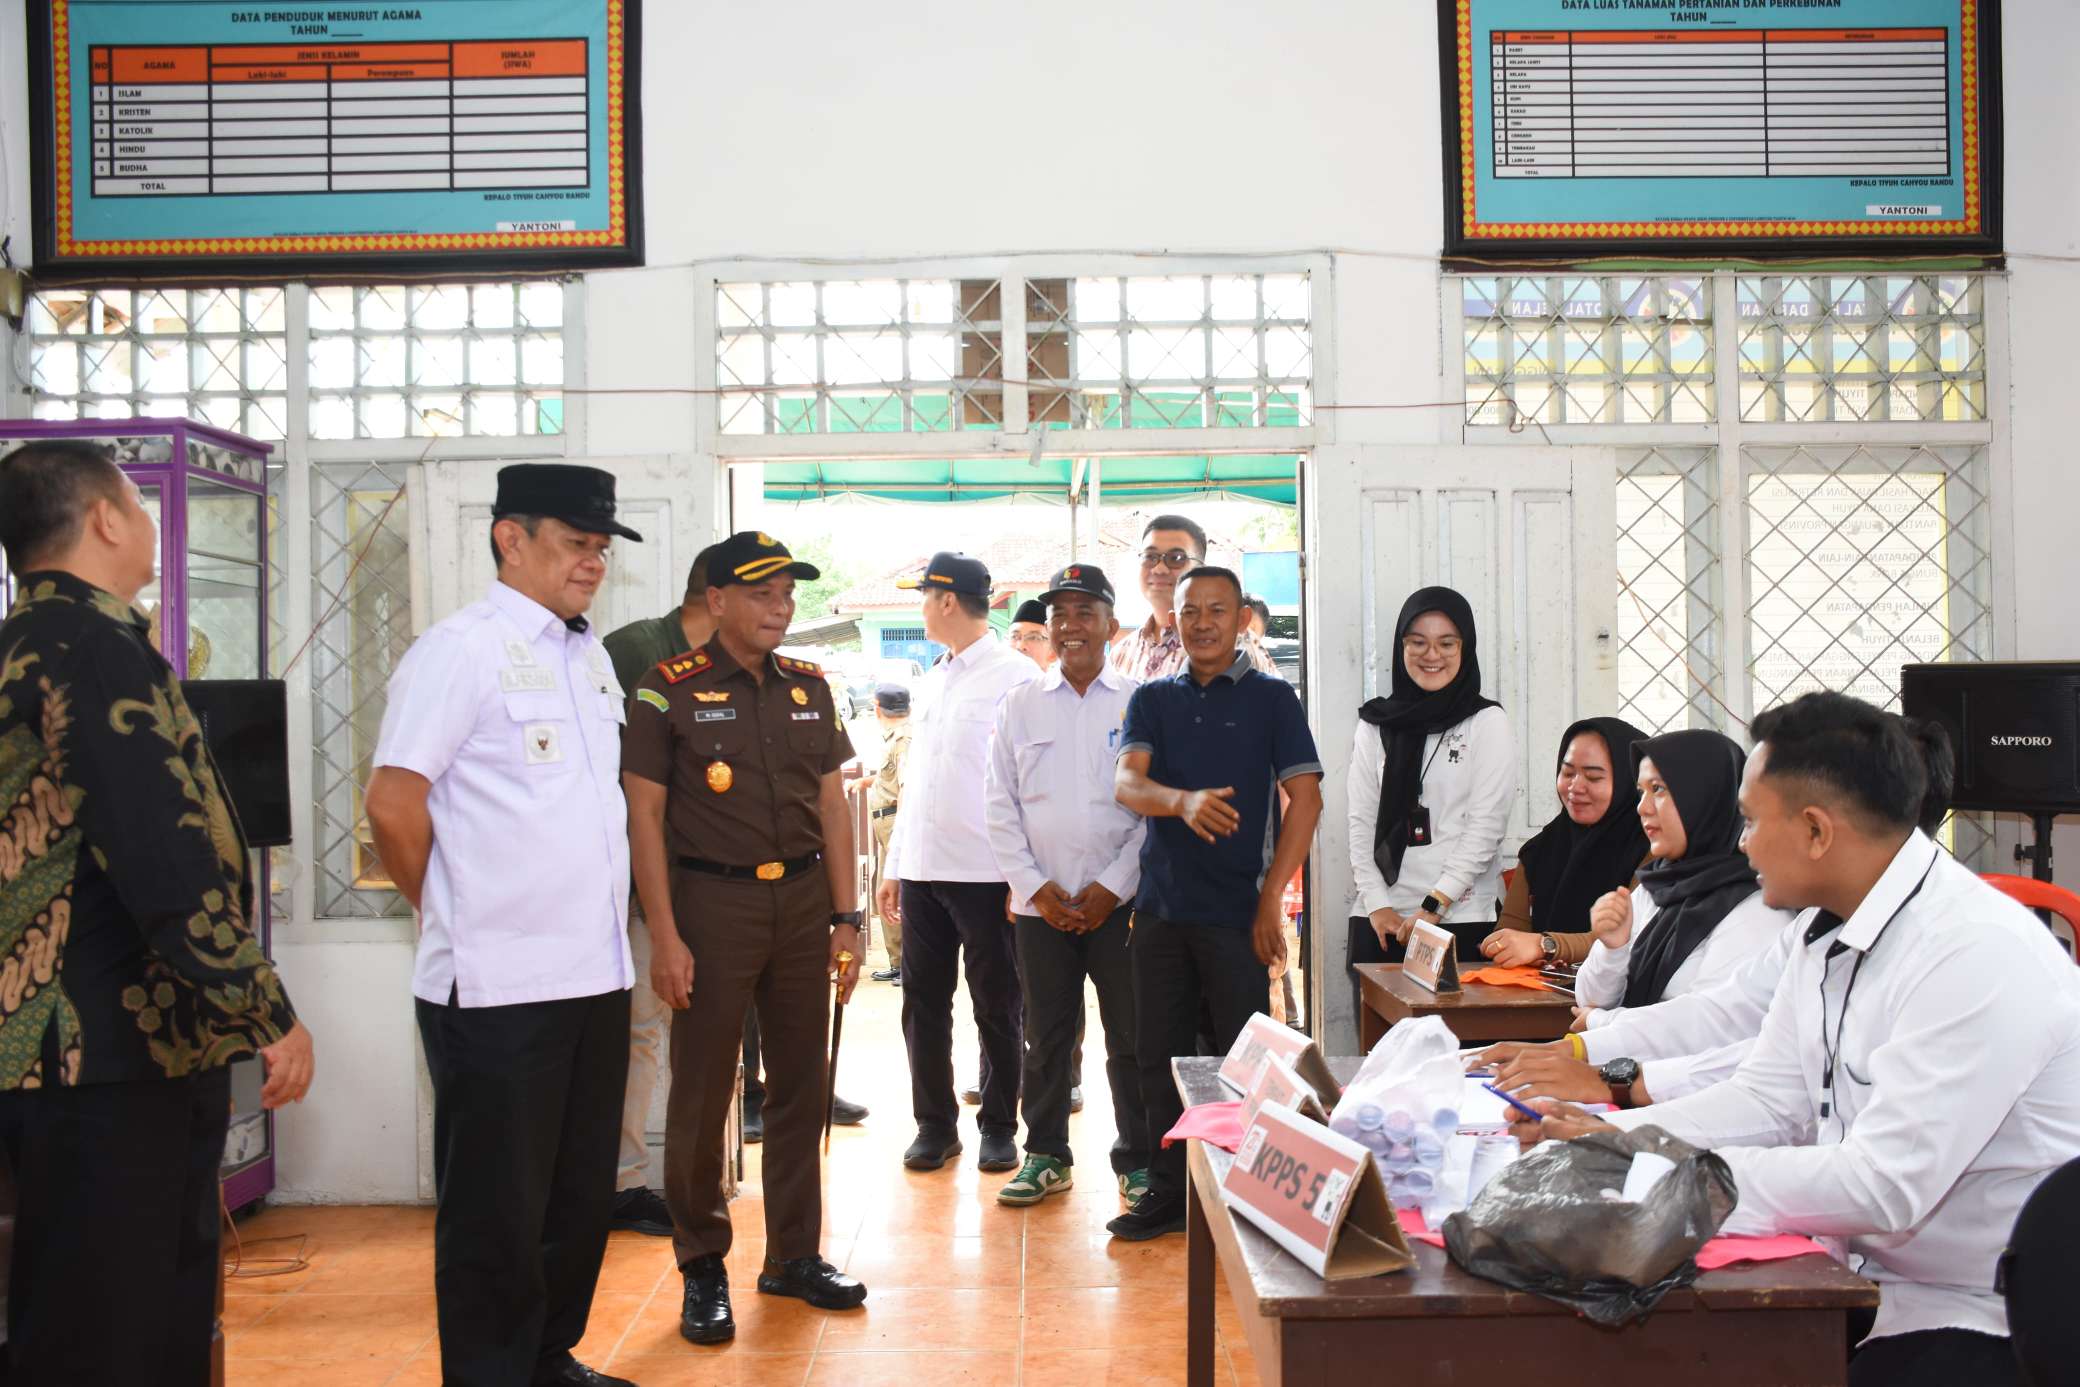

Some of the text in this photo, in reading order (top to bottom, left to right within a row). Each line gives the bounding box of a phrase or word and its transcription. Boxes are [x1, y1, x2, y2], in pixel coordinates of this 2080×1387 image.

[1562, 0, 1590, 10] DATA
[1624, 0, 1683, 9] TANAMAN
[1686, 0, 1741, 9] PERTANIAN
[1744, 0, 1767, 8] DAN
[1770, 0, 1841, 8] PERKEBUNAN
[231, 10, 422, 23] DATA PENDUDUK MENURUT AGAMA
[1670, 12, 1708, 22] TAHUN
[291, 25, 328, 35] TAHUN
[144, 61, 176, 70] AGAMA
[118, 108, 151, 116] KRISTEN
[118, 127, 153, 135] KATOLIK
[119, 145, 146, 153] HINDU
[119, 164, 148, 172] BUDHA
[140, 182, 166, 190] TOTAL
[1880, 206, 1928, 215] YANTONI
[512, 222, 561, 231] YANTONI
[1990, 735, 2052, 746] SAPPORO
[1249, 1141, 1328, 1211] KPPS 5
